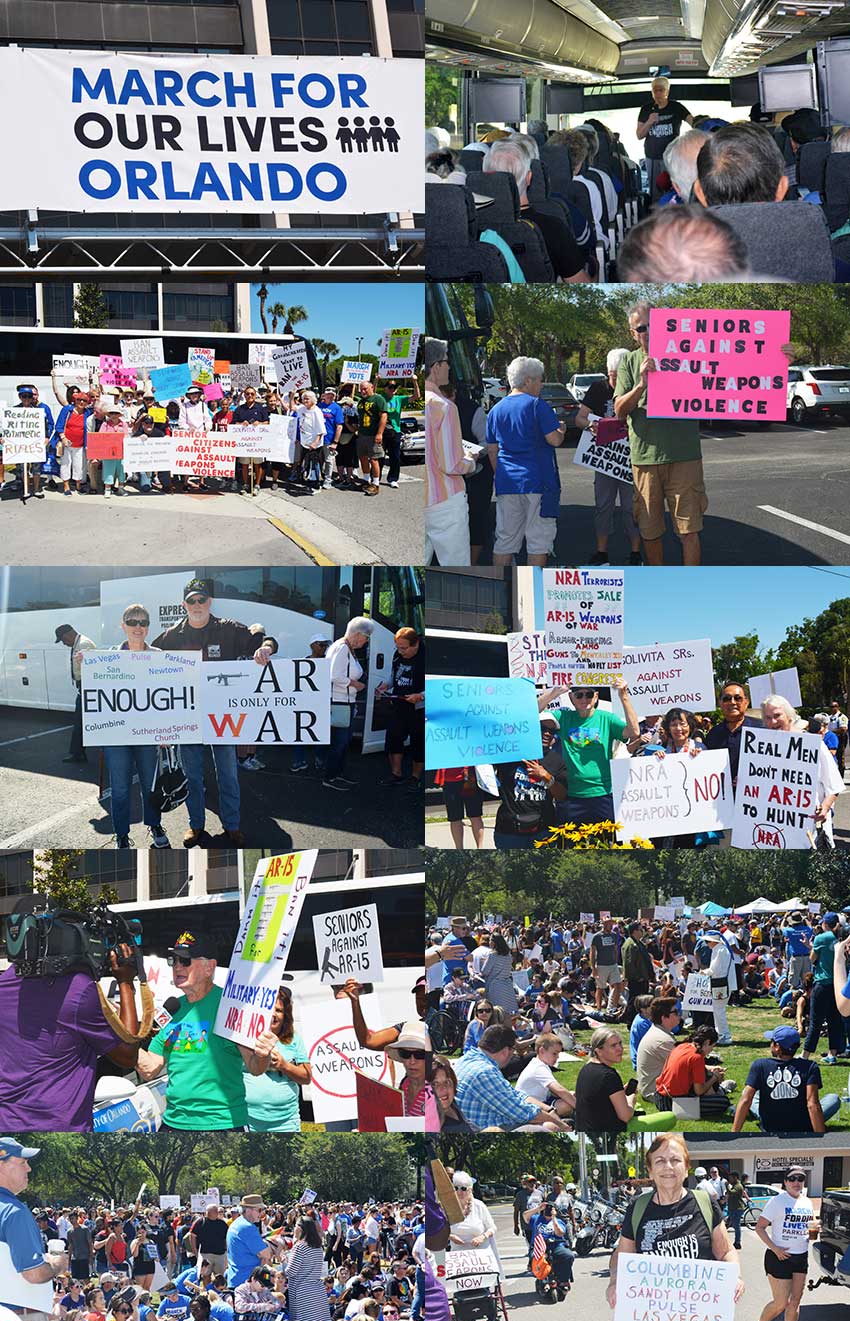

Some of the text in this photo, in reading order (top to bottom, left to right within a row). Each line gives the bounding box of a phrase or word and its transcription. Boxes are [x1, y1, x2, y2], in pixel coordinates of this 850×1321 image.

[72, 67, 369, 108] MARCH FOR
[74, 112, 328, 152] OUR LIVES
[78, 159, 347, 201] ORLANDO
[666, 319, 765, 334] SENIORS
[665, 340, 764, 353] AGAINST
[348, 372, 364, 380] VOTE
[702, 376, 783, 390] WEAPONS
[672, 399, 767, 414] VIOLENCE
[173, 430, 207, 439] SENIOR
[196, 454, 235, 462] ASSAULT
[556, 571, 581, 585] NRA
[580, 601, 593, 609] OF
[84, 653, 121, 665] Las Vegas
[131, 653, 151, 661] Pulse
[165, 653, 196, 667] Parkland
[93, 671, 136, 680] Bernardino
[106, 666, 120, 674] San
[149, 666, 184, 675] Newtown
[254, 660, 320, 693] AR
[552, 673, 572, 685] FIRE
[84, 686, 195, 713] ENOUGH!
[228, 697, 296, 708] IS ONLY FOR
[85, 718, 126, 732] Columbine
[132, 723, 199, 736] Sutherland Springs
[207, 711, 320, 742] WAR
[154, 732, 180, 742] Church
[629, 764, 668, 783] NRA
[782, 769, 812, 785] NEED
[694, 772, 725, 802] NO!
[744, 785, 759, 798] AN
[621, 786, 672, 803] ASSAULT
[622, 805, 679, 821] WEAPONS
[743, 803, 809, 829] TO HUNT
[325, 909, 371, 936] SENIORS
[331, 933, 368, 953] AGAINST
[338, 952, 369, 974] AR-15
[315, 1055, 383, 1073] WEAPONS
[626, 1260, 726, 1281] COLUMBINE
[456, 1277, 482, 1288] NOW
[640, 1276, 707, 1290] AURORA
[626, 1286, 720, 1303] SANDY HOOK
[649, 1300, 696, 1313] PULSE
